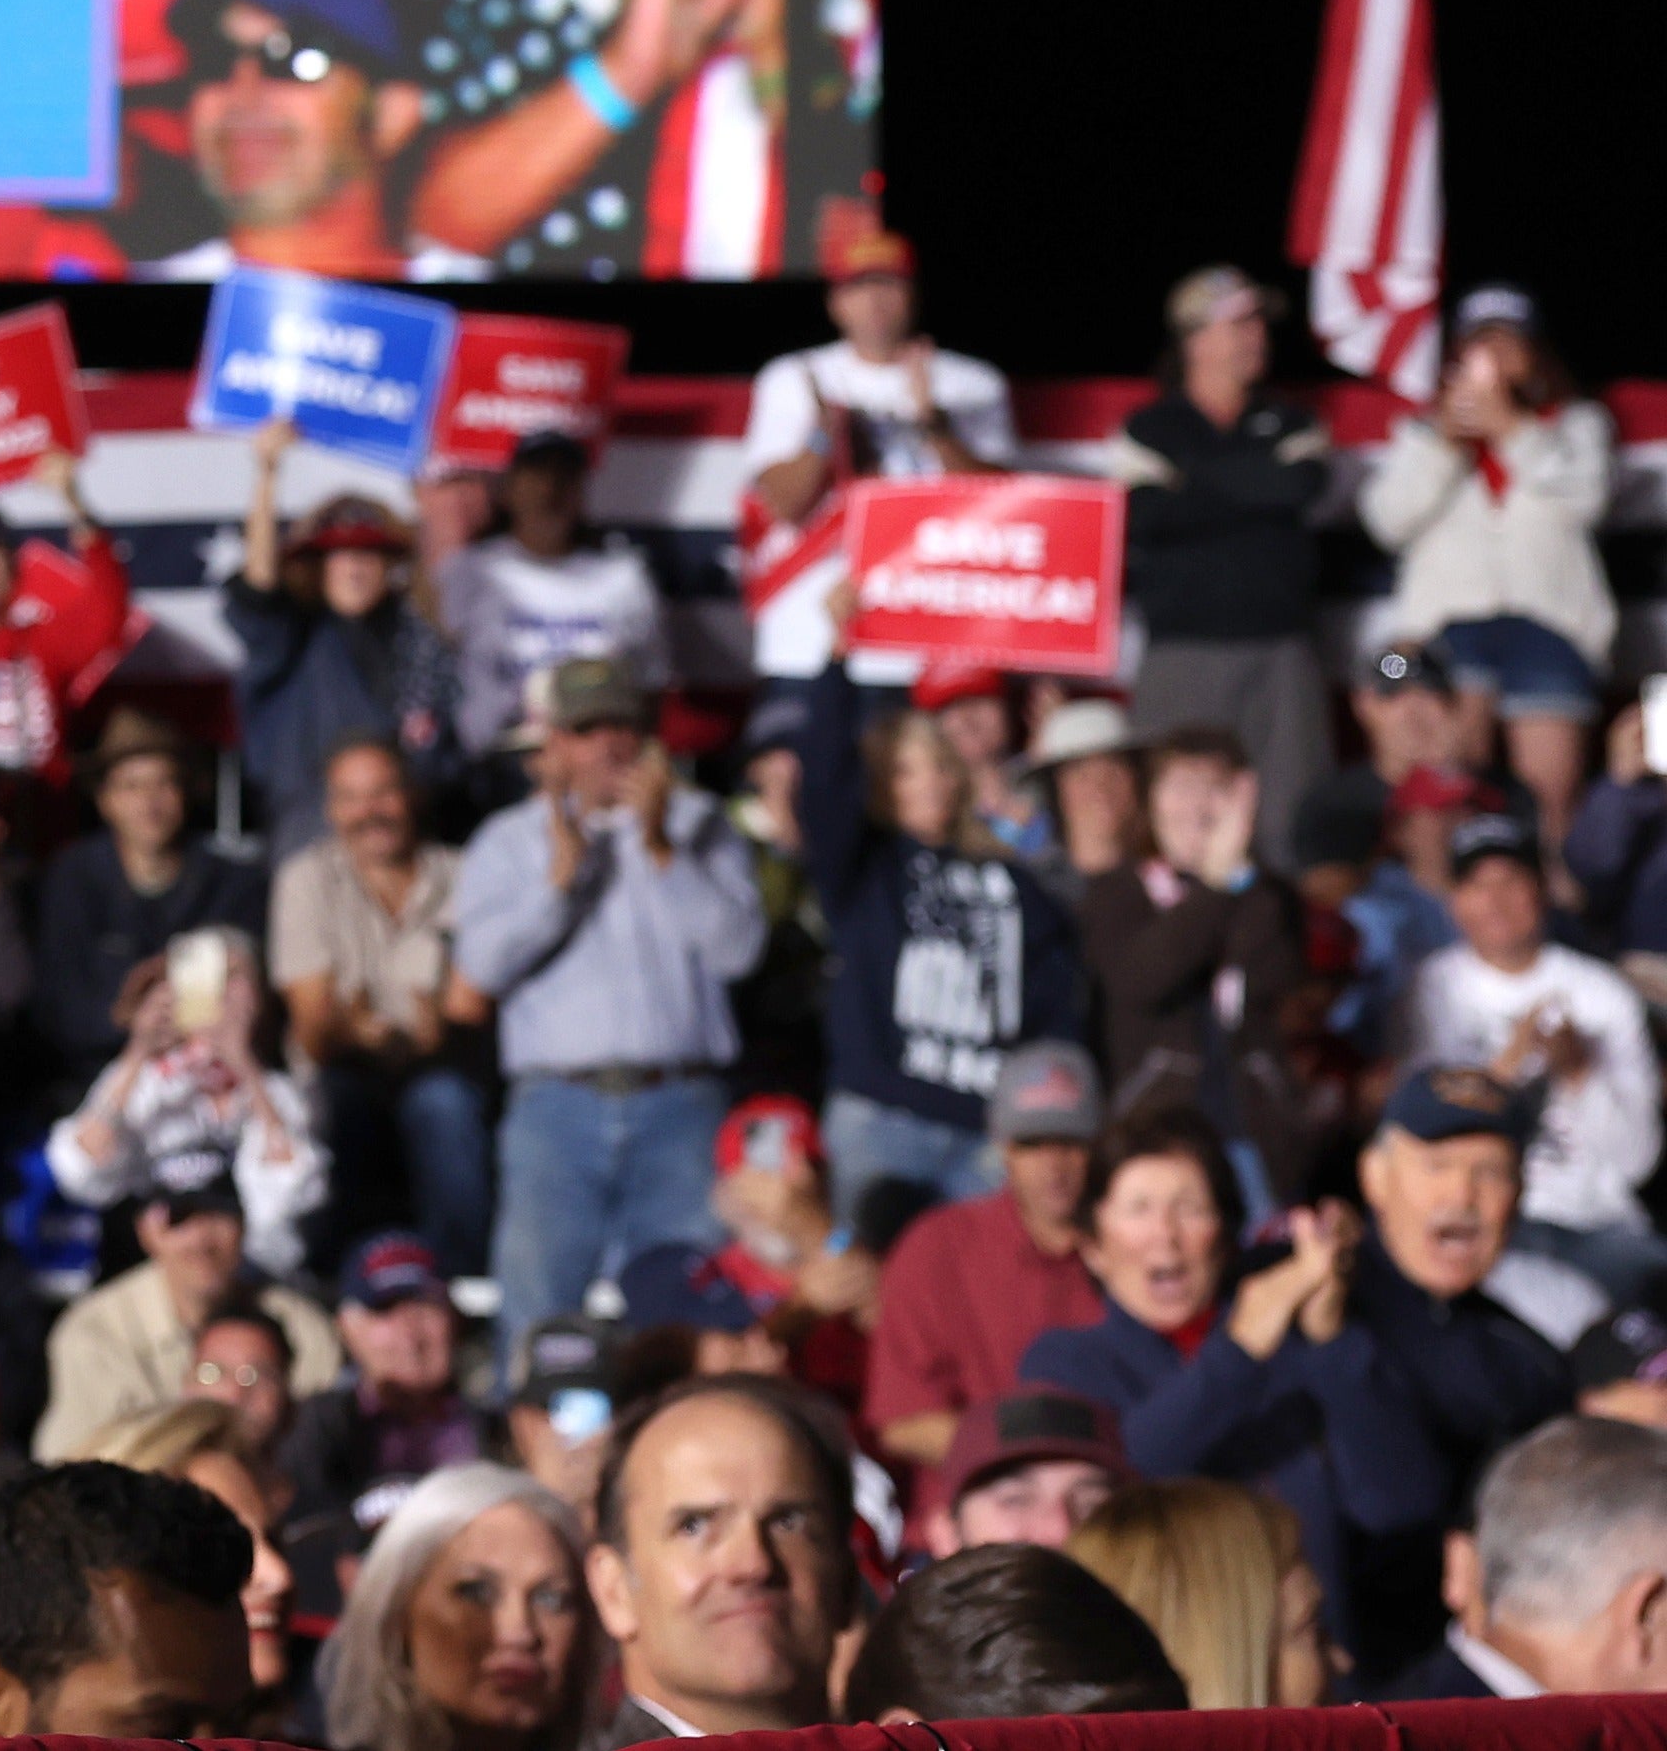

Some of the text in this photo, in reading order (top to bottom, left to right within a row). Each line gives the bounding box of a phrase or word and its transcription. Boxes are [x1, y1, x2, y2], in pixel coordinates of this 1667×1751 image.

[269, 312, 385, 372] SAVE
[913, 515, 1048, 572] SAVE
[858, 559, 1099, 626] AMERICA!
